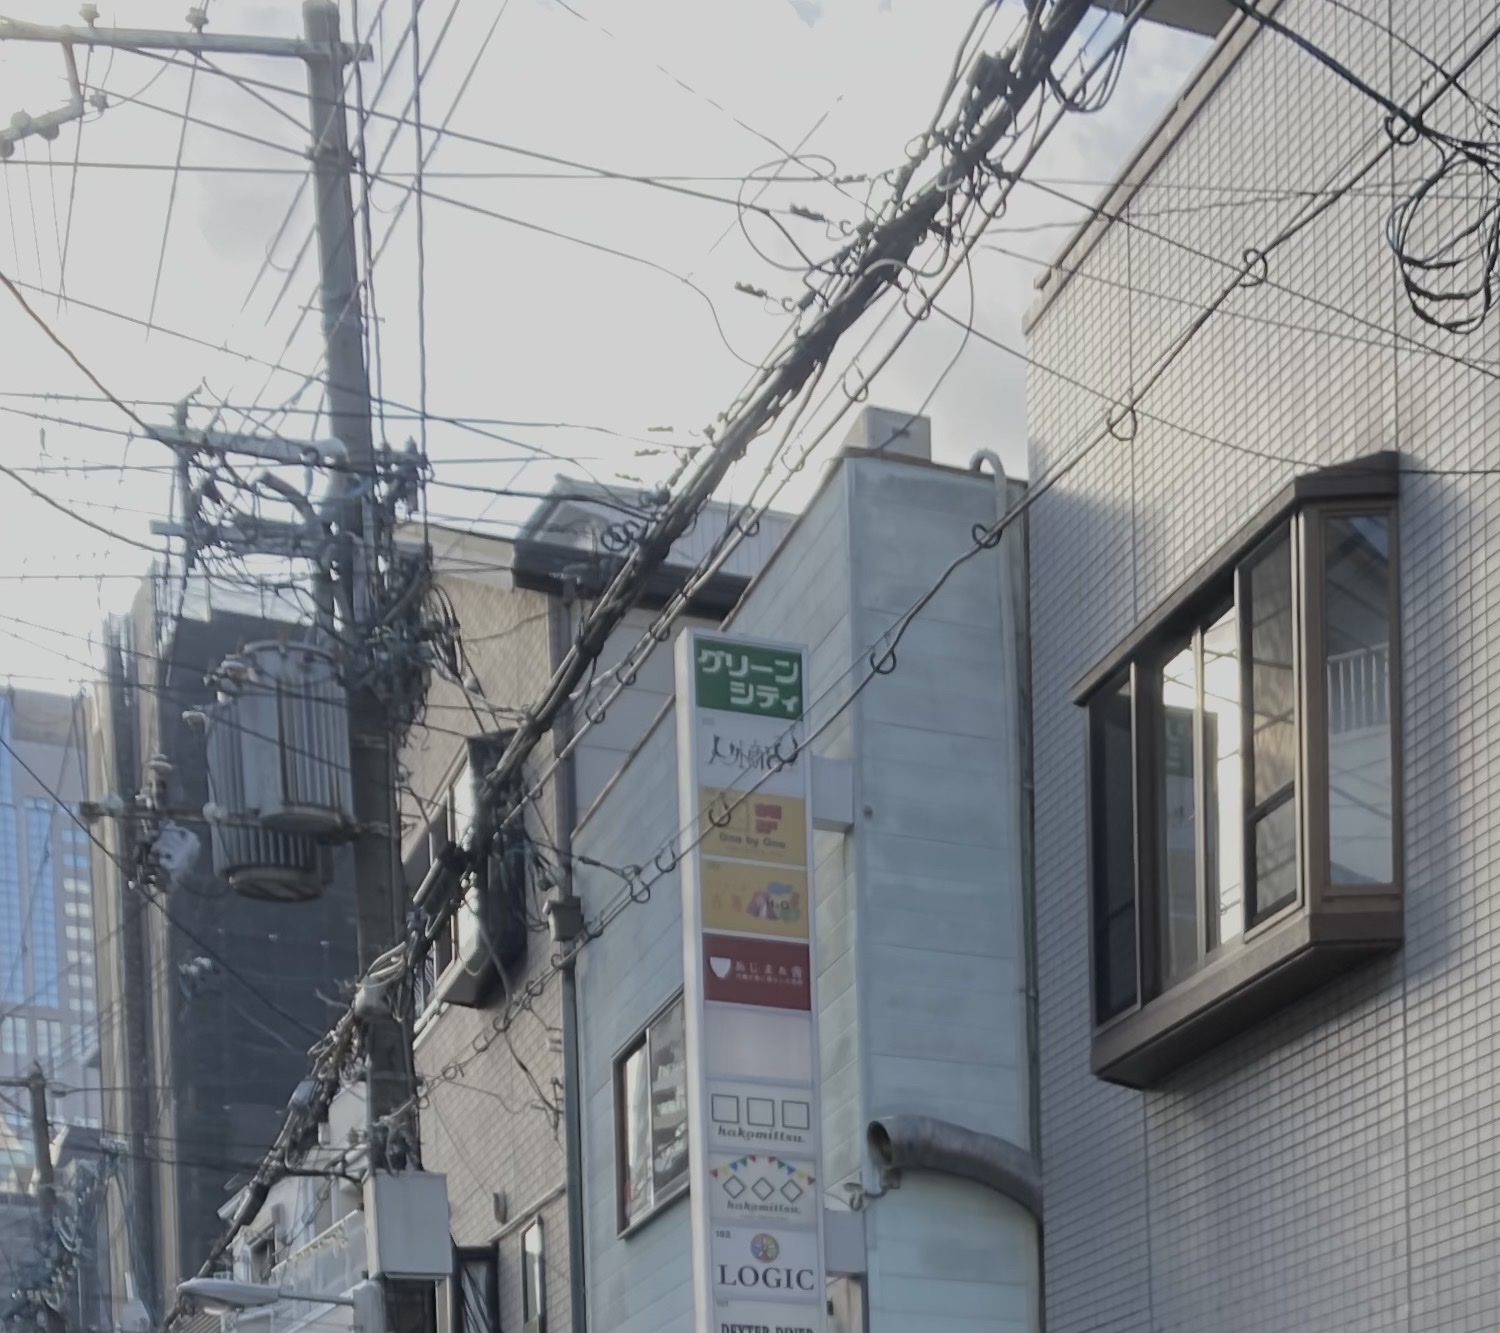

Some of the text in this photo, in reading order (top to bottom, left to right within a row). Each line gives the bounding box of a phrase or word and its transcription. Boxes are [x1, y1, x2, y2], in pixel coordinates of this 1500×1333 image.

[698, 648, 799, 684] グリーン
[729, 681, 799, 713] シティ
[718, 1264, 815, 1291] LOGIC
